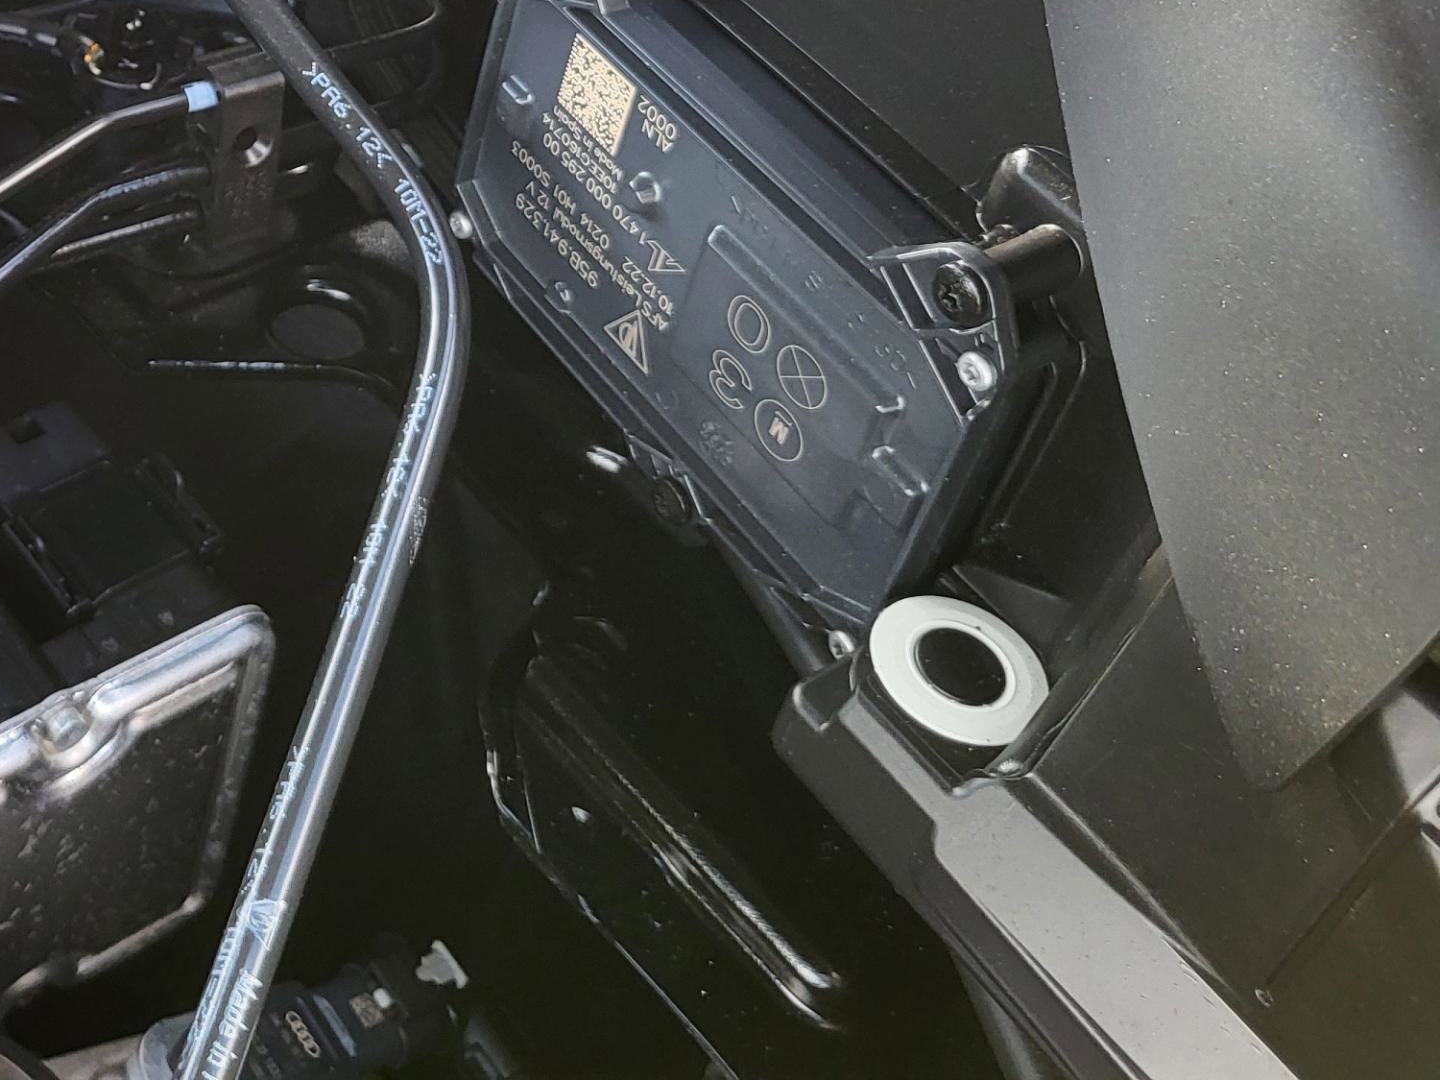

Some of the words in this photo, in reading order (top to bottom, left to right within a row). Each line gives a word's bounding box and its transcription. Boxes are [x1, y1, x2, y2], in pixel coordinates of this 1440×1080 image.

[553, 105, 582, 140] Spain
[636, 94, 677, 139] 0002
[542, 134, 561, 157] 00
[641, 121, 673, 153] ALN
[560, 153, 586, 182] 295
[594, 148, 624, 181] Made
[536, 189, 551, 212] 12
[585, 178, 613, 210] 000
[579, 212, 610, 249] 0214
[612, 204, 640, 236] 470
[641, 301, 670, 331] AFS
